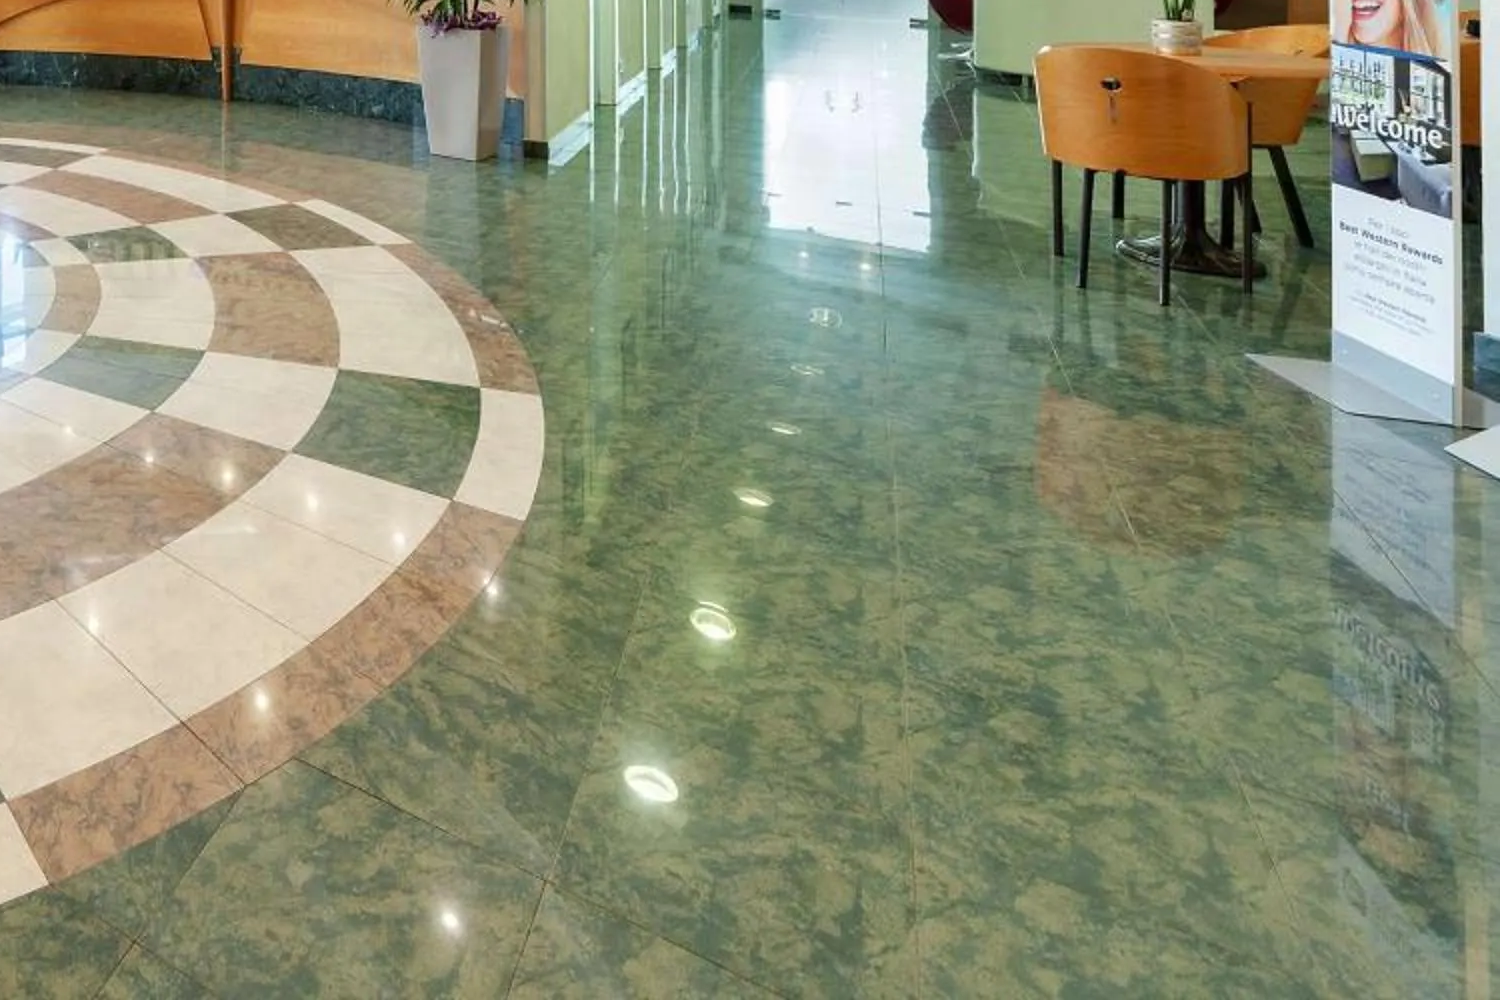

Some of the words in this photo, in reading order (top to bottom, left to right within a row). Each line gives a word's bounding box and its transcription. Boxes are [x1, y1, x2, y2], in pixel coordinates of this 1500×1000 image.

[1339, 219, 1360, 235] Best
[1361, 229, 1399, 249] Western
[1401, 242, 1444, 266] Rewards
